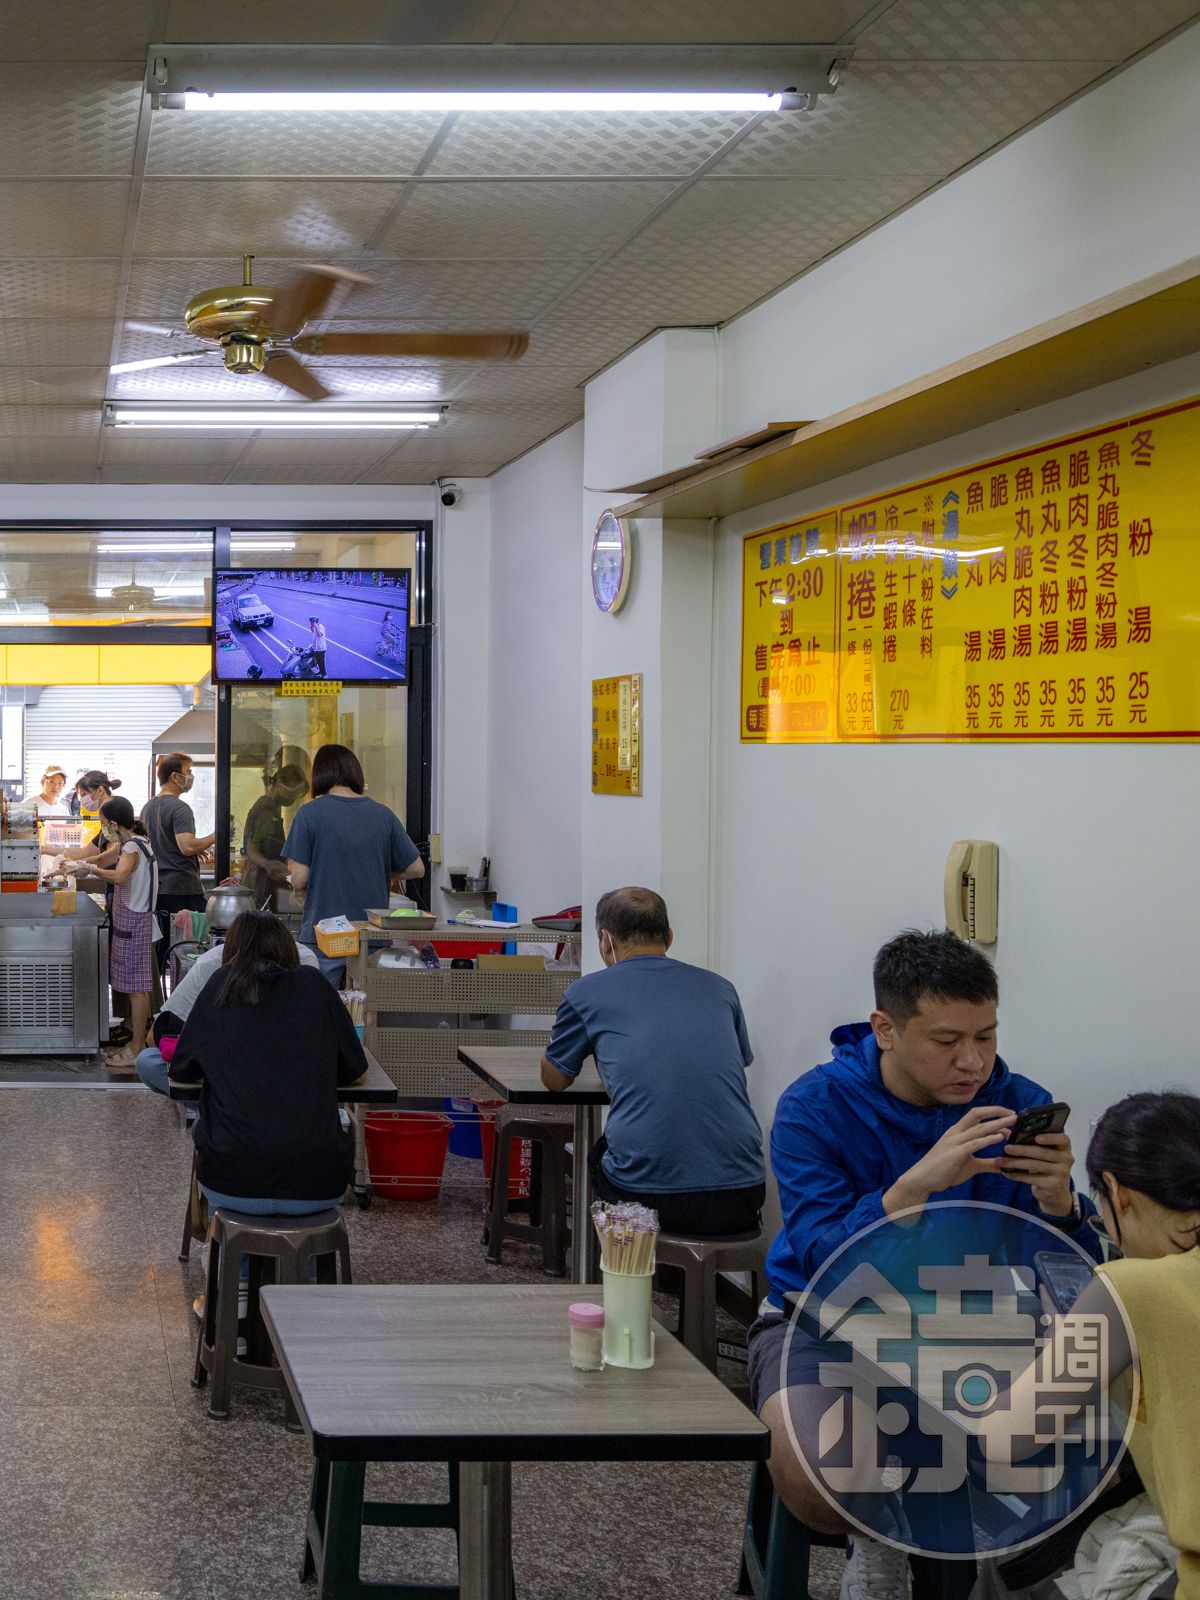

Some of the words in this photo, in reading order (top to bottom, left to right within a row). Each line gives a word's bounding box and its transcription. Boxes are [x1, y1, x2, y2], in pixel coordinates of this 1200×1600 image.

[779, 608, 794, 636] 到
[1012, 467, 1034, 658] 魚丸脆肉湯
[1038, 459, 1061, 655] 魚丸冬粉湯
[1065, 450, 1090, 653] 脆肉冬粉湯
[1095, 441, 1120, 650] 魚丸脆肉冬粉湯
